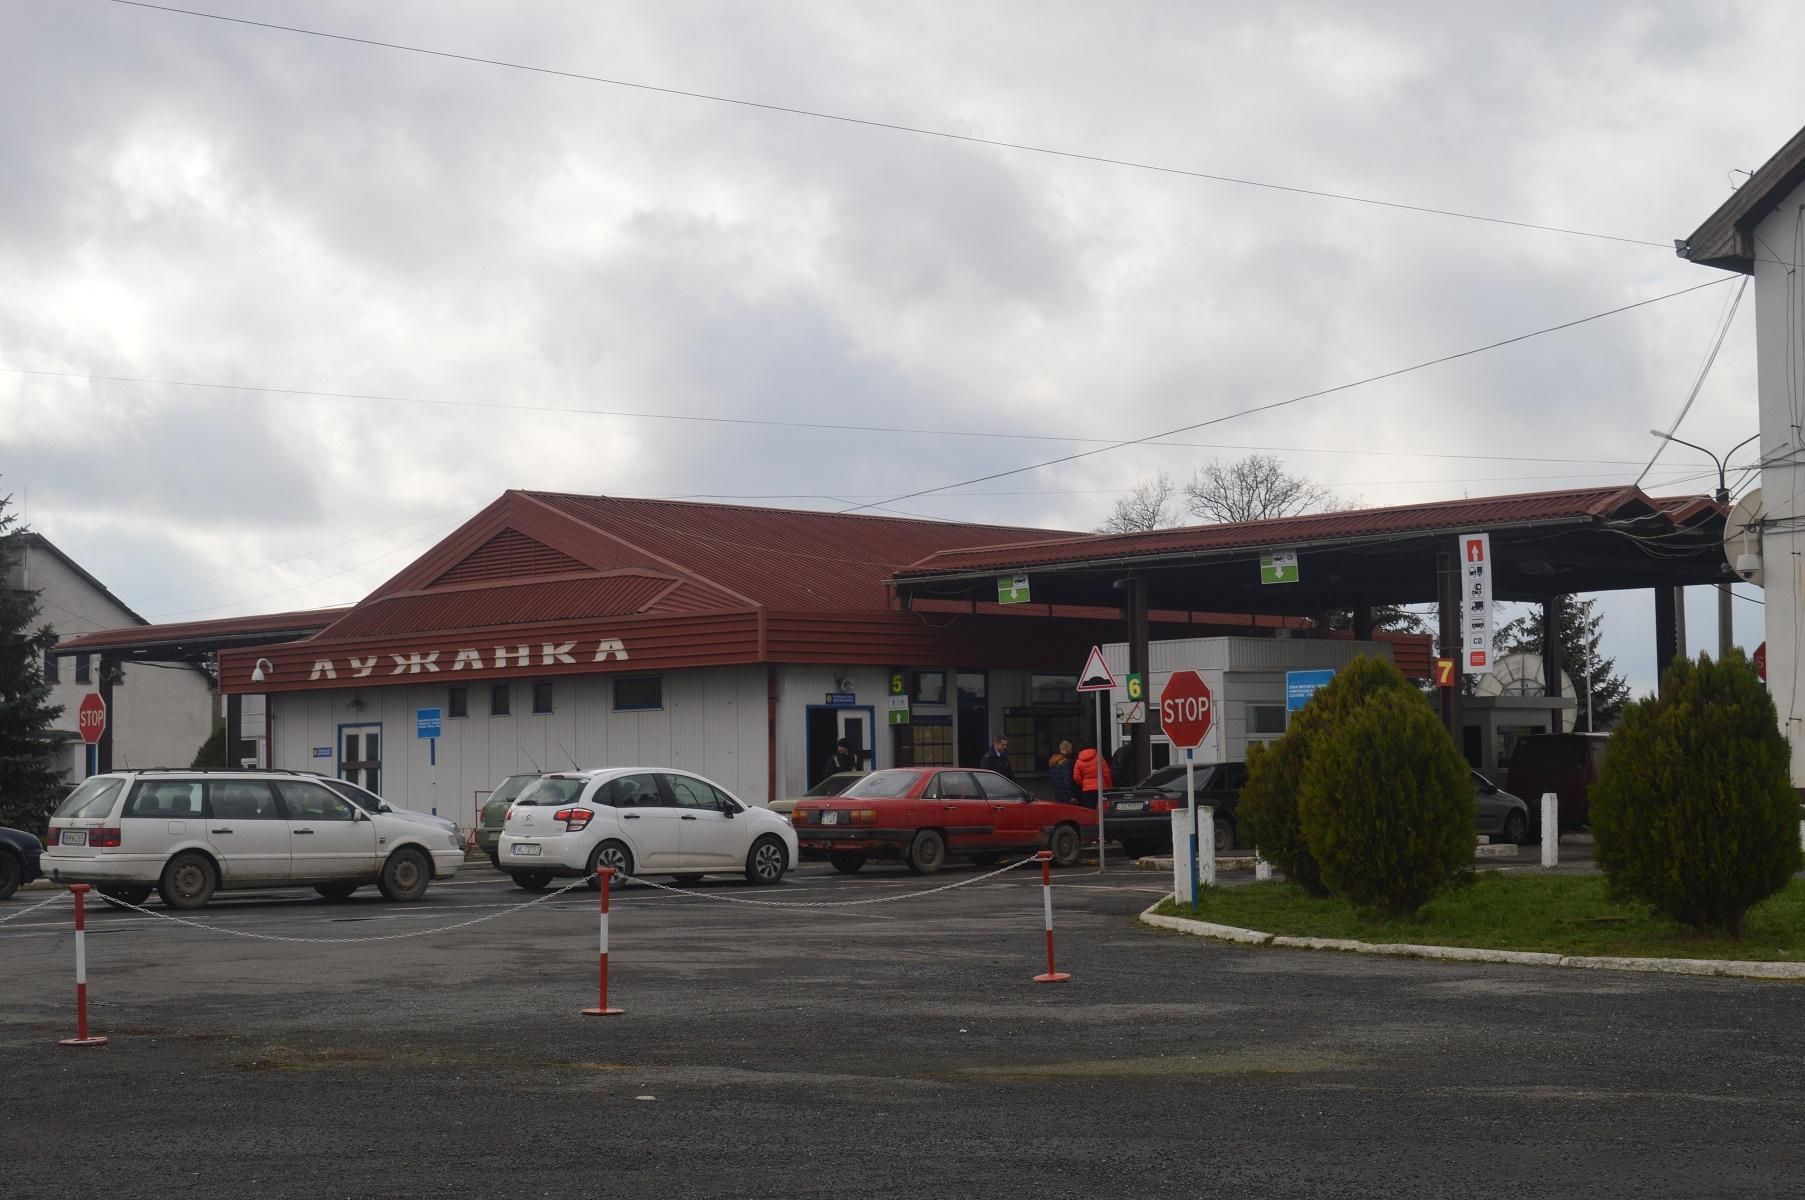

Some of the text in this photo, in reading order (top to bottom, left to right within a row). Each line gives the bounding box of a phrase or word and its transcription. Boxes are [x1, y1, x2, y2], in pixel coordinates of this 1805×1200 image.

[1473, 637, 1483, 645] CD
[307, 637, 630, 681] ЛУЖАНКА
[1438, 661, 1453, 683] 7
[892, 674, 903, 692] 5
[1128, 678, 1141, 698] 6
[80, 710, 104, 727] STOP
[1163, 696, 1209, 723] STOP
